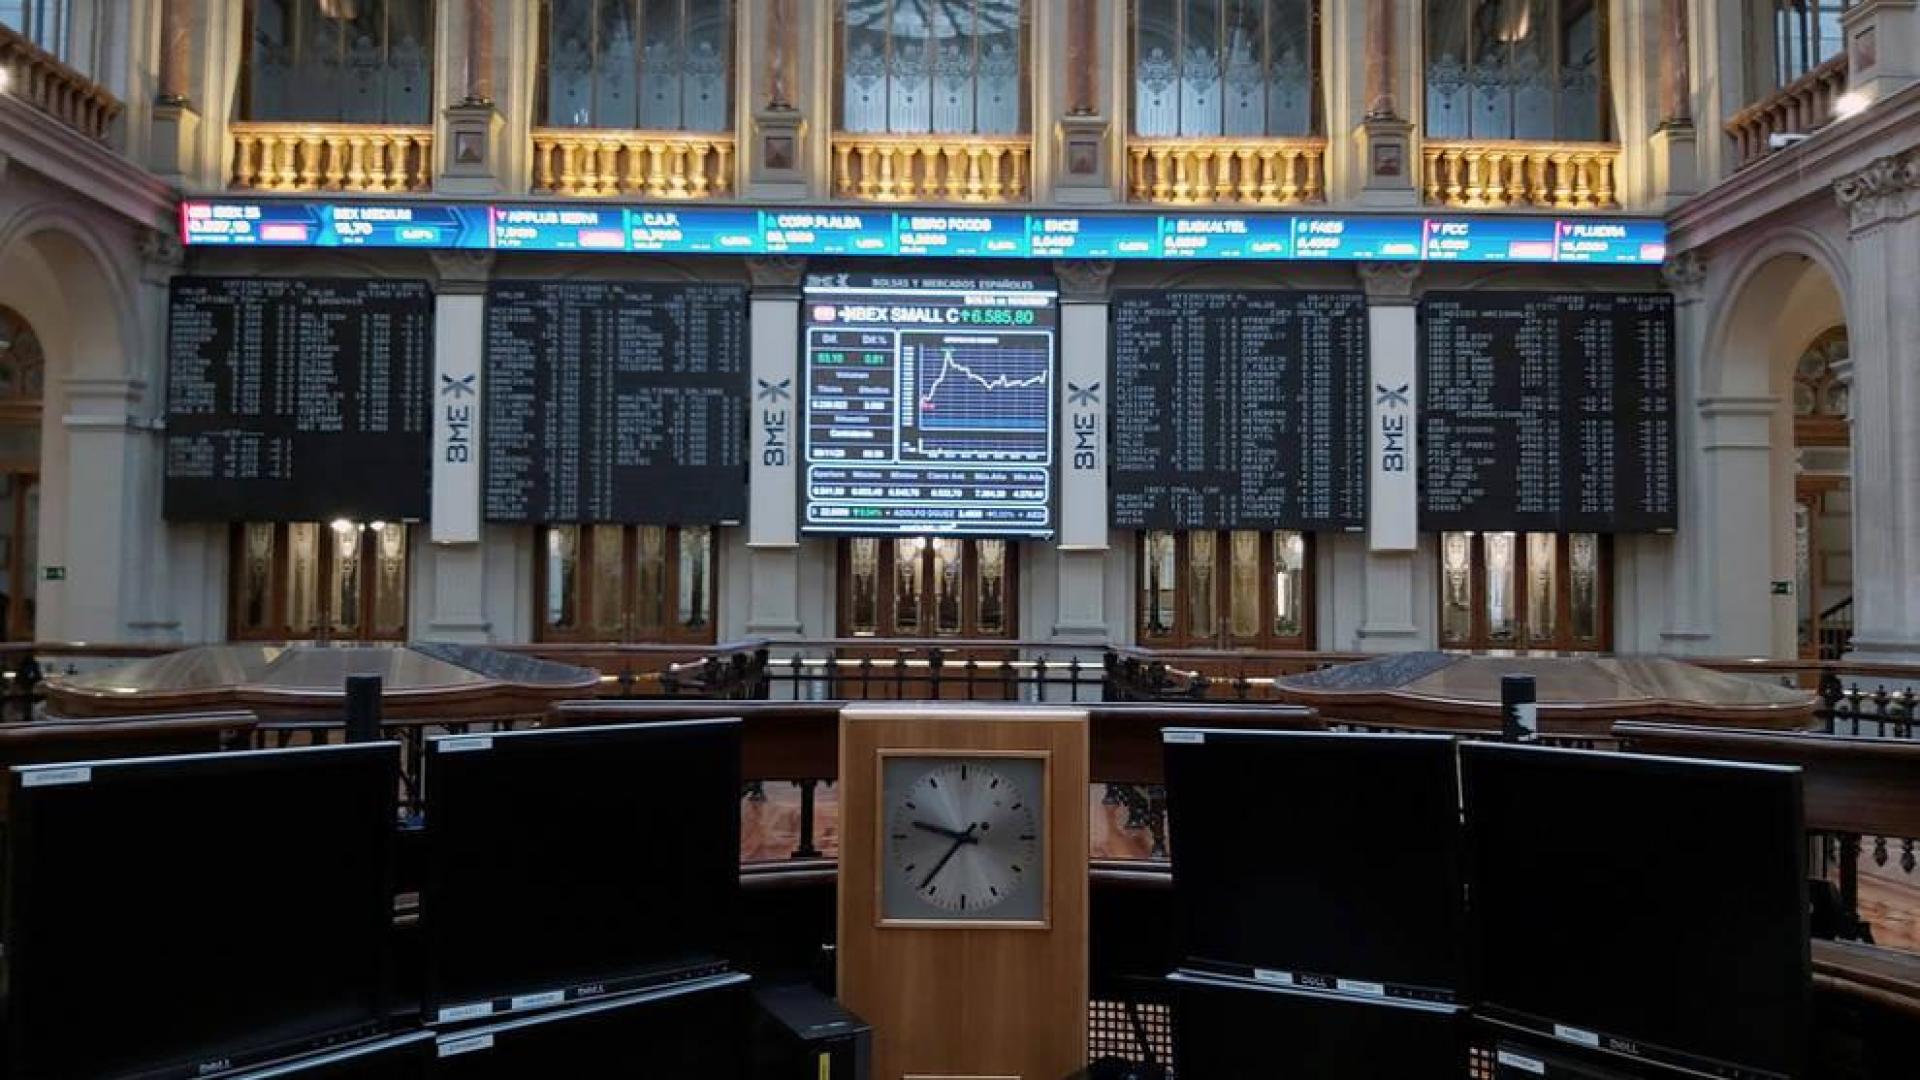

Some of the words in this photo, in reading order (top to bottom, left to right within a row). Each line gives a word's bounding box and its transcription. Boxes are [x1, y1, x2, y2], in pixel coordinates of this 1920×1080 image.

[871, 278, 909, 288] BOLSAS
[912, 279, 920, 288] Y
[922, 279, 976, 289] MERCADOS
[979, 278, 1034, 290] ESPAÑOLES
[890, 307, 944, 323] SMALL
[945, 307, 960, 324] C
[970, 309, 1035, 326] 6.585,80
